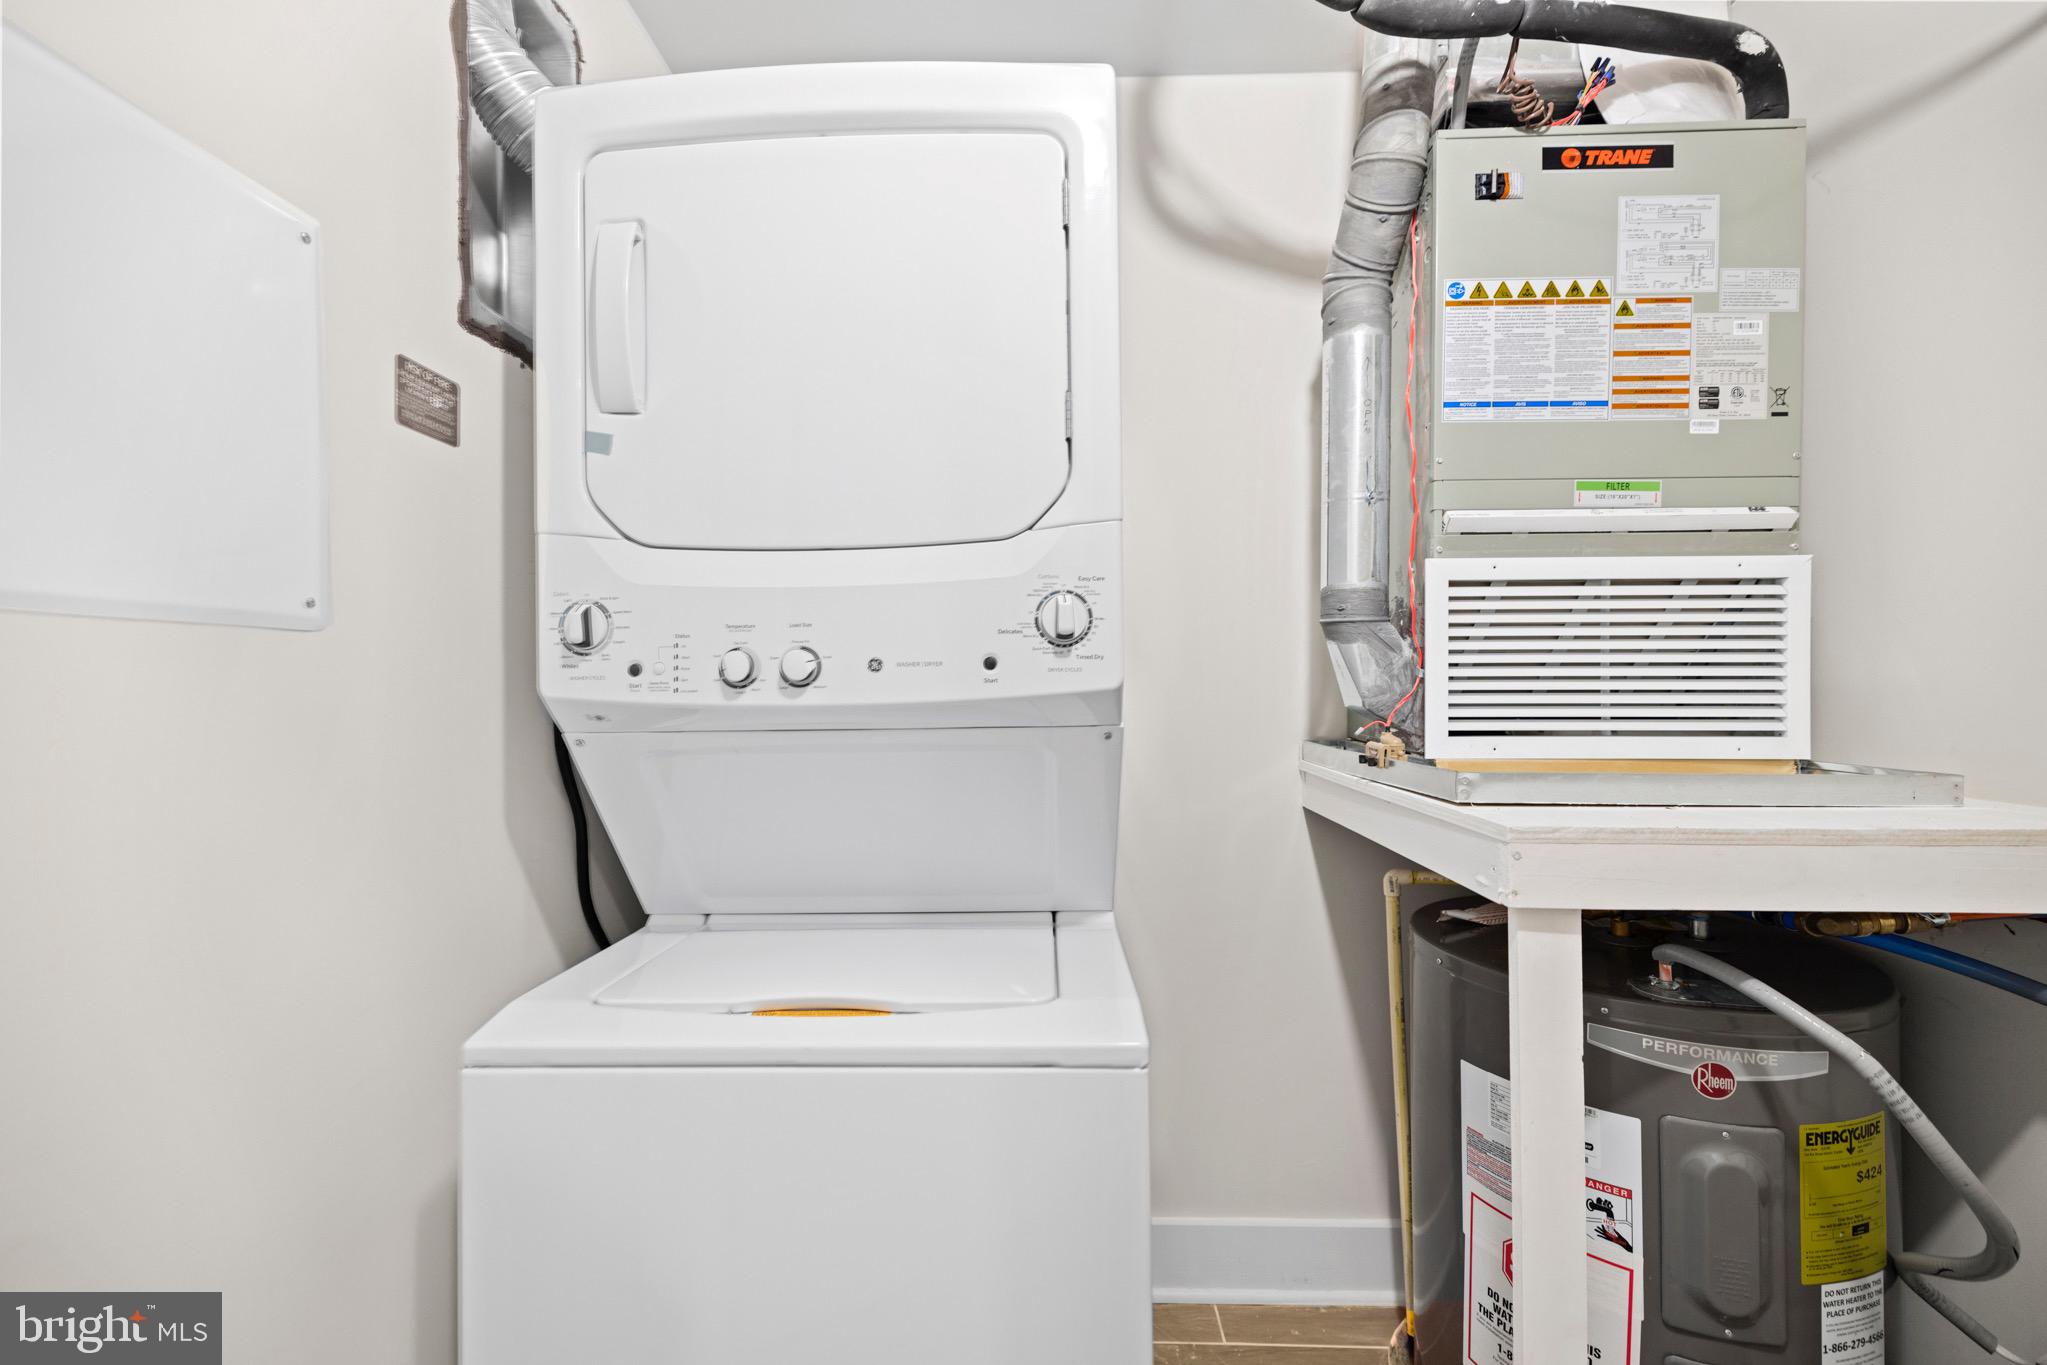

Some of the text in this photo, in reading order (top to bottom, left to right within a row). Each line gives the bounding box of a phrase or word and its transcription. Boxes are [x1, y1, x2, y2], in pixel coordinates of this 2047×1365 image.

[1584, 149, 1653, 166] TRANE
[1606, 482, 1630, 490] FILTER
[1642, 1037, 1778, 1067] PERFORMANCE
[1697, 1063, 1735, 1093] Rheem
[1805, 1120, 1881, 1147] ENERGYGUIDE
[1856, 1164, 1882, 1184] $424
[1586, 1178, 1628, 1198] ANGER
[1602, 1218, 1617, 1227] HOT
[1487, 1287, 1500, 1304] DO
[1824, 1290, 1835, 1298] DO
[1836, 1288, 1849, 1296] NOT
[1850, 1283, 1872, 1294] RETURN
[1823, 1299, 1845, 1308] WATER
[1846, 1295, 1866, 1305] HEATER
[1867, 1292, 1874, 1300] TO
[1826, 1299, 1881, 1318] PLACE OF PURCHASE
[1478, 1302, 1495, 1323] THE
[1587, 1344, 1602, 1359] IS
